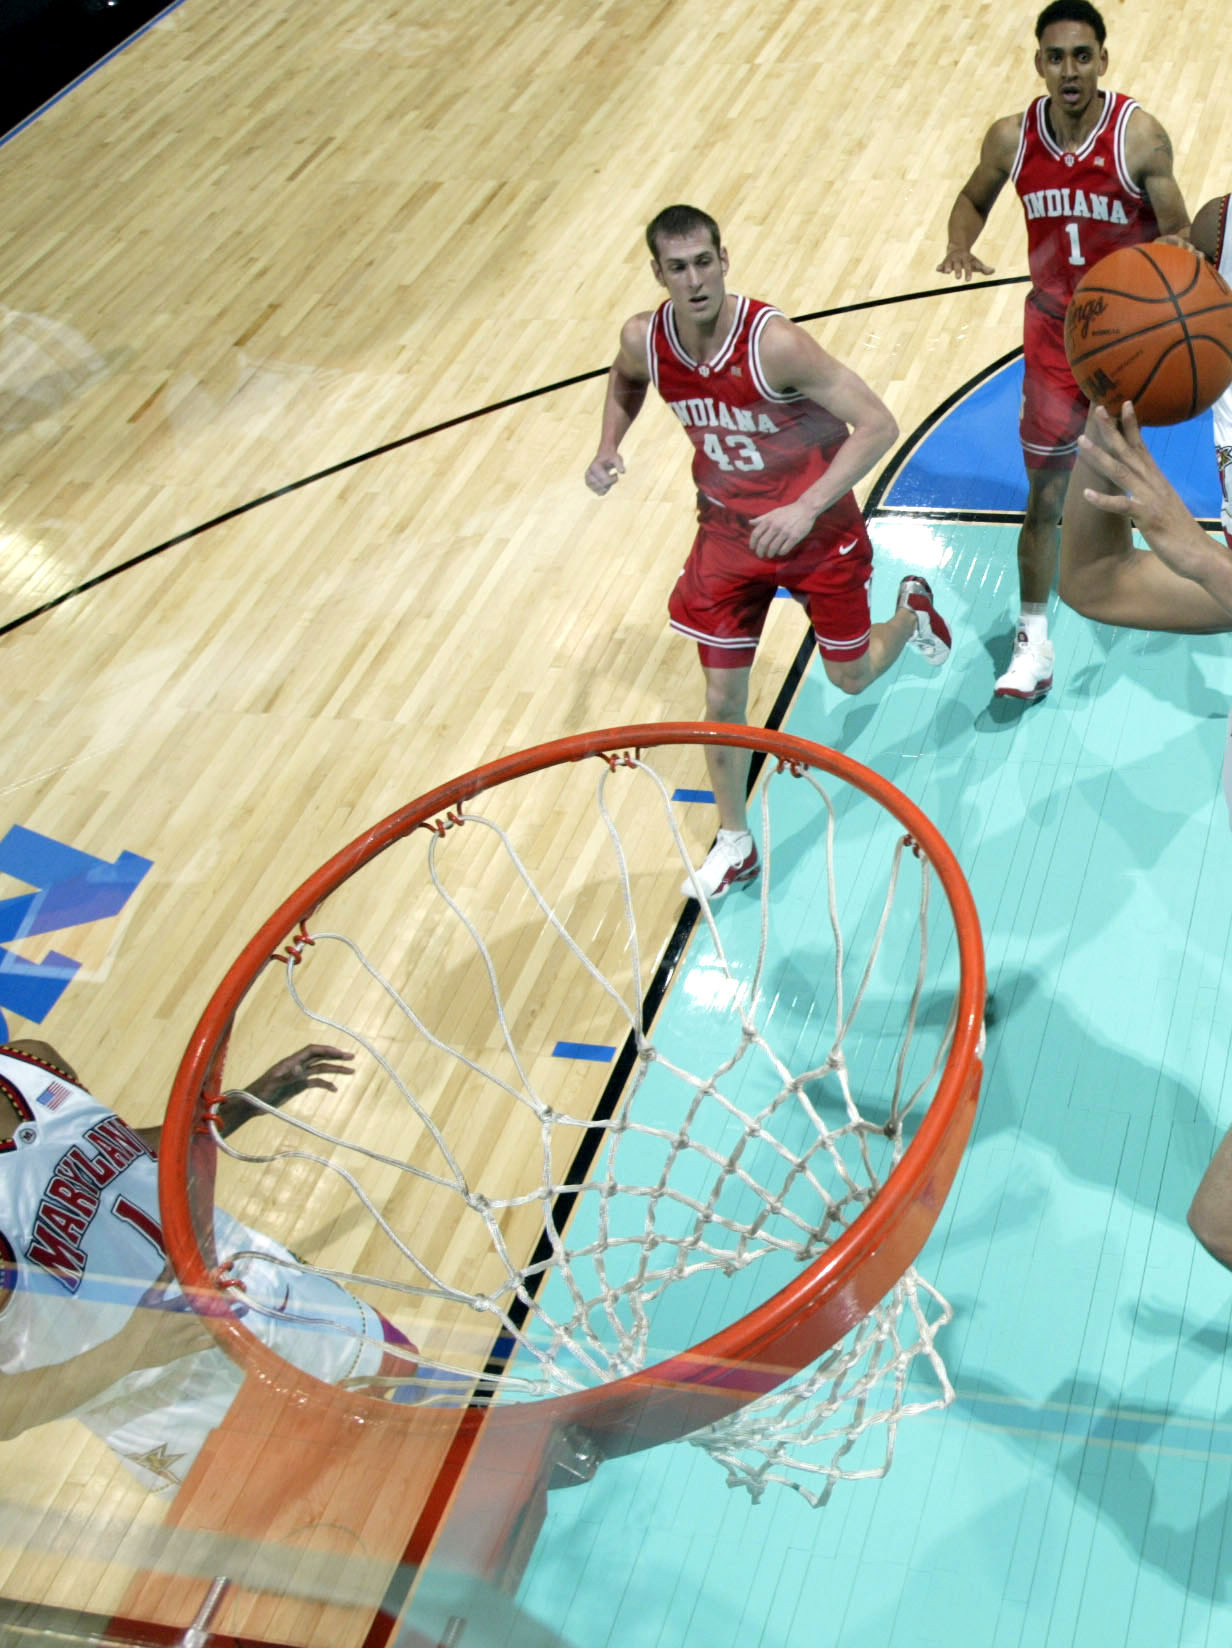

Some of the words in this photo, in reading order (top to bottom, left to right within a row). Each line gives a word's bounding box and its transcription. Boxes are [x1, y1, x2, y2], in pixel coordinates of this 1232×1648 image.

[1022, 187, 1129, 225] INDIANA
[1064, 222, 1087, 267] 1
[668, 397, 780, 433] NDIANA
[703, 433, 765, 471] 43
[25, 1114, 158, 1294] MARYLAN
[110, 1193, 169, 1262] 1
